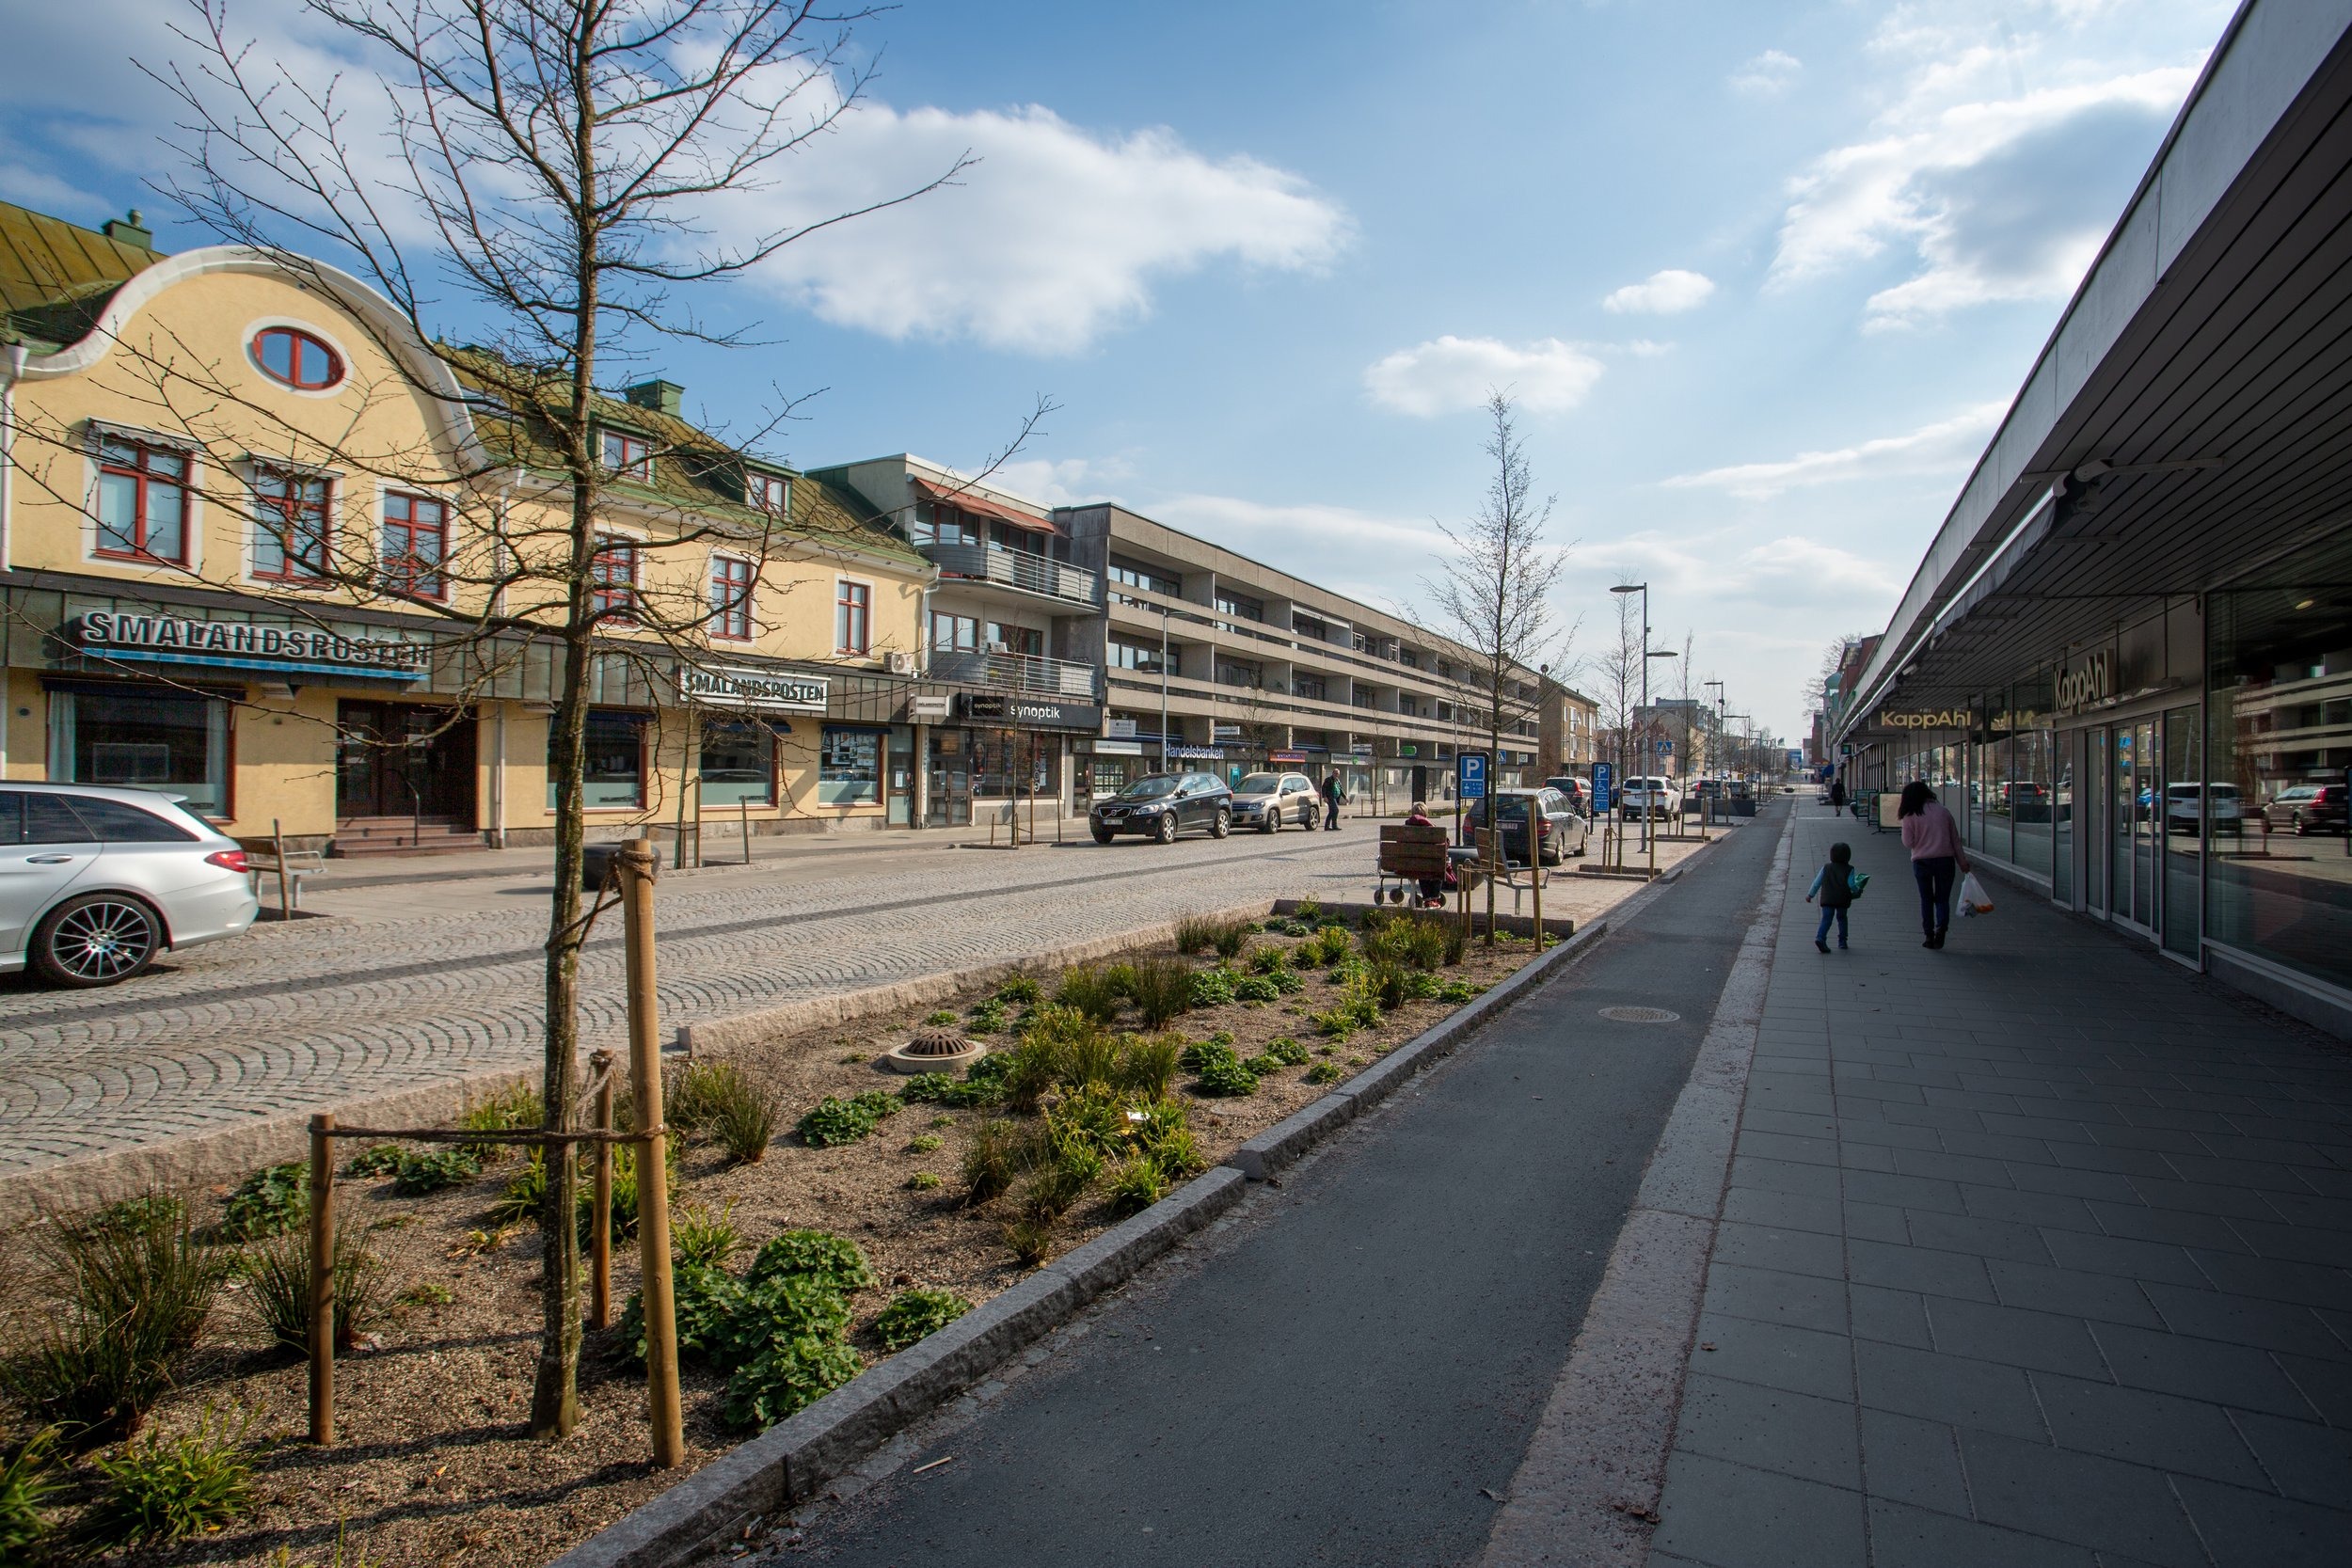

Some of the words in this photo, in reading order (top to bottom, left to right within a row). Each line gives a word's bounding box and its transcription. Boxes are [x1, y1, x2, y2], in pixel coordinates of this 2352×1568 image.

[2054, 649, 2109, 715] KappAhl
[1010, 704, 1061, 720] synoptik
[1881, 710, 1972, 729] KappAhl
[1165, 743, 1224, 760] Handelsbanken
[1467, 758, 1480, 778] P
[1597, 766, 1607, 778] P
